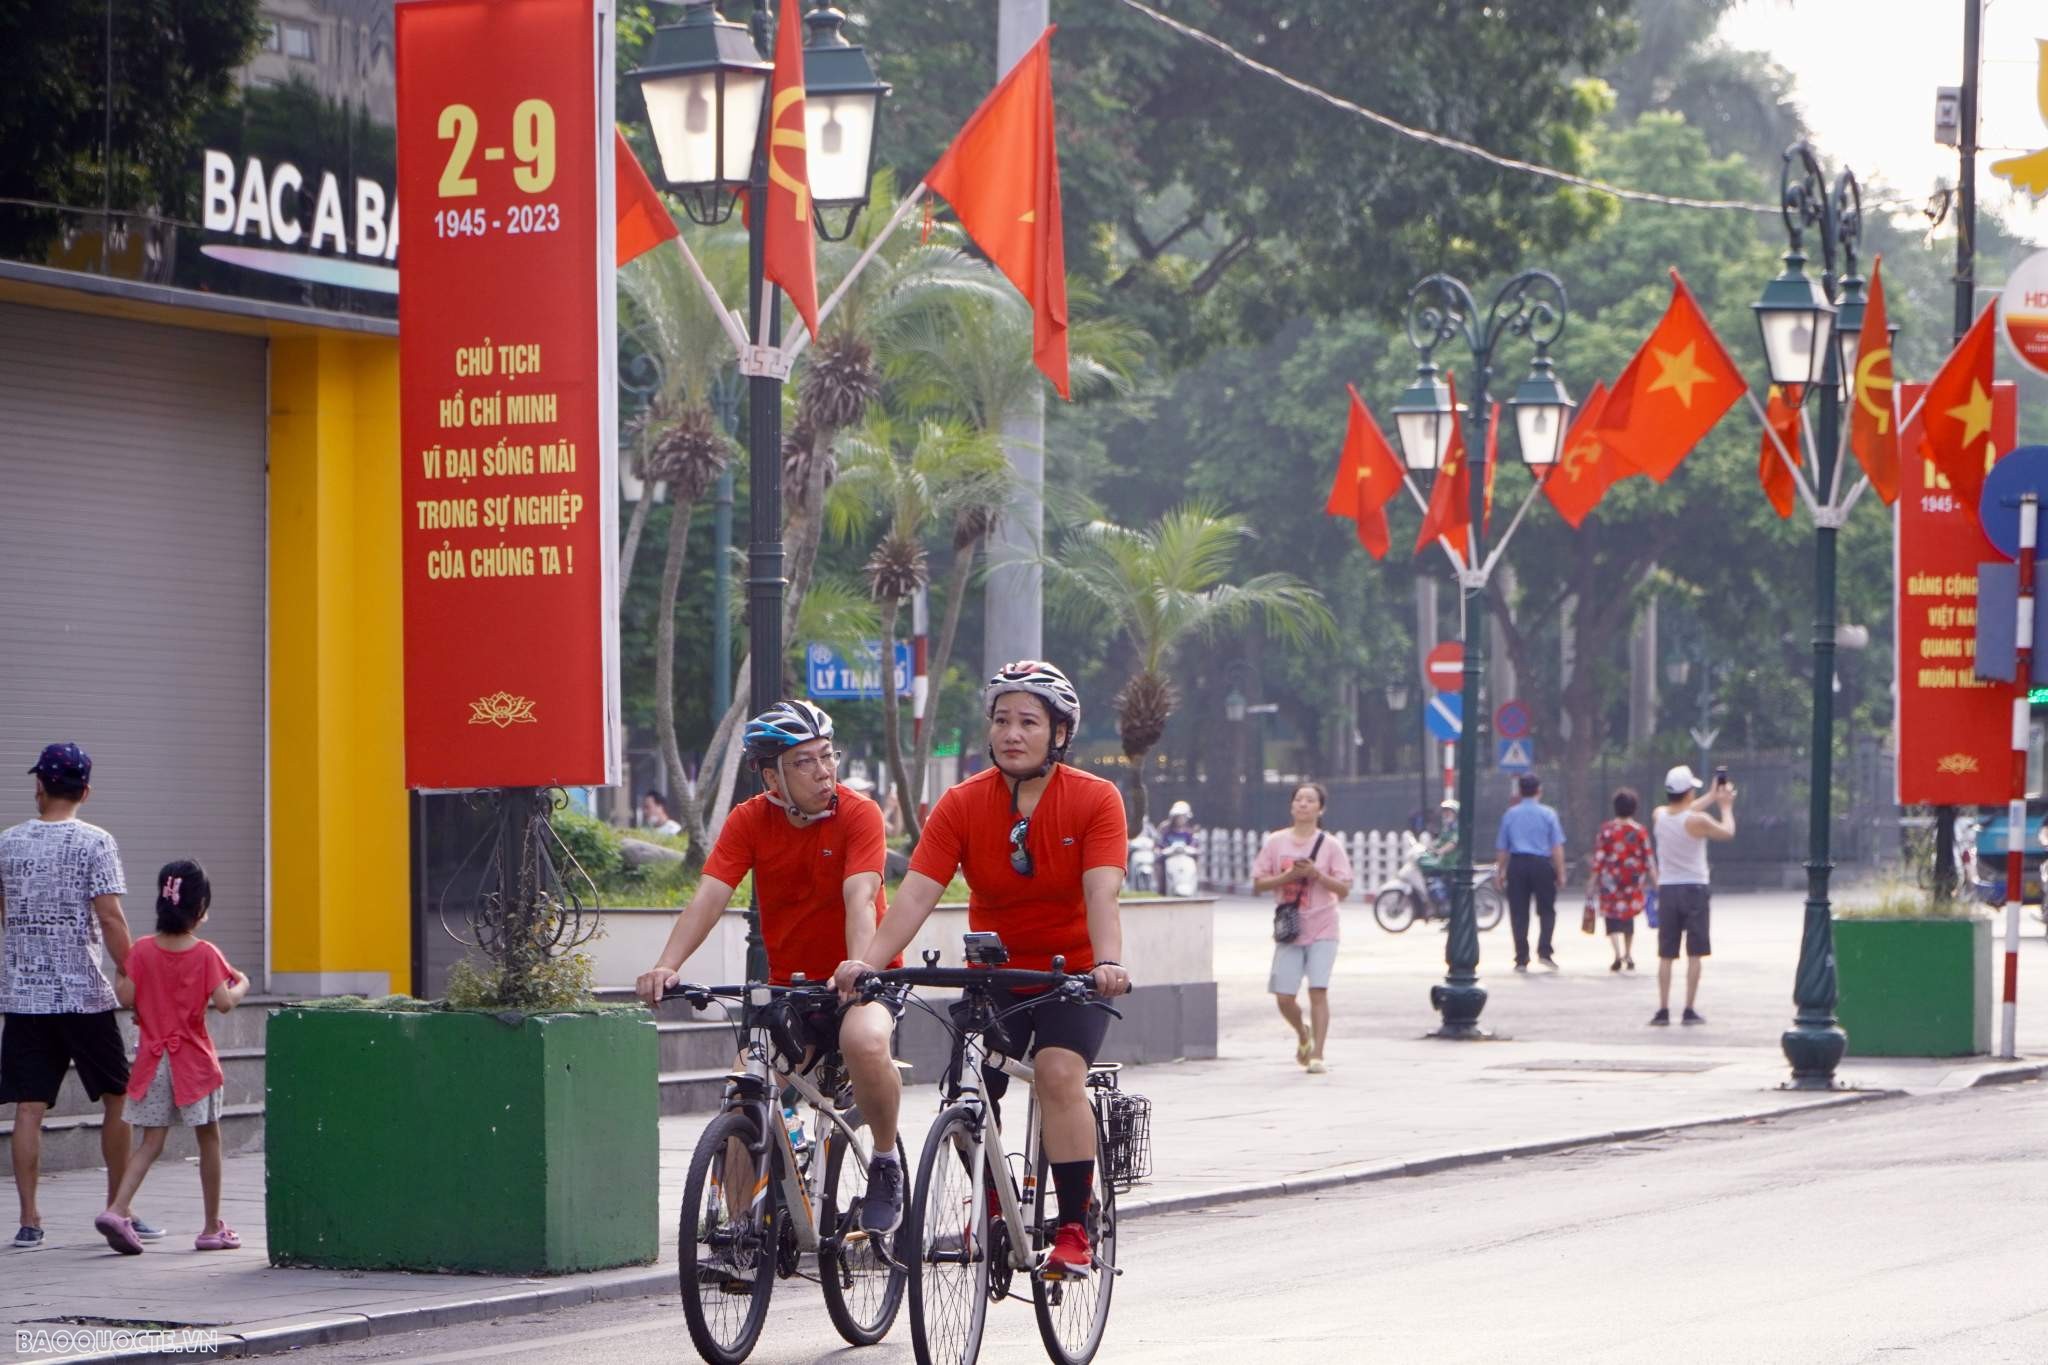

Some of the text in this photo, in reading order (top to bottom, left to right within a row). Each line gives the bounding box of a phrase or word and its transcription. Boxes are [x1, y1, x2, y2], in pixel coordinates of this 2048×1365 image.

[437, 98, 556, 198] 2-9
[203, 149, 303, 245] BAC
[310, 170, 348, 254] A
[434, 208, 486, 238] 1945
[506, 203, 560, 234] 2023
[455, 336, 540, 380] CHỦ TỊCH
[439, 388, 557, 428] HỒ CHÍ MINH
[422, 437, 577, 484] VĨ ĐẠI SỐNG MÃI
[416, 488, 583, 533] TRONG SỰ NGHIỆP
[427, 540, 466, 580] CỦA
[470, 542, 534, 577] CHÚNG
[539, 546, 561, 576] TA
[1956, 606, 1977, 627] NA
[816, 664, 836, 690] LÝ
